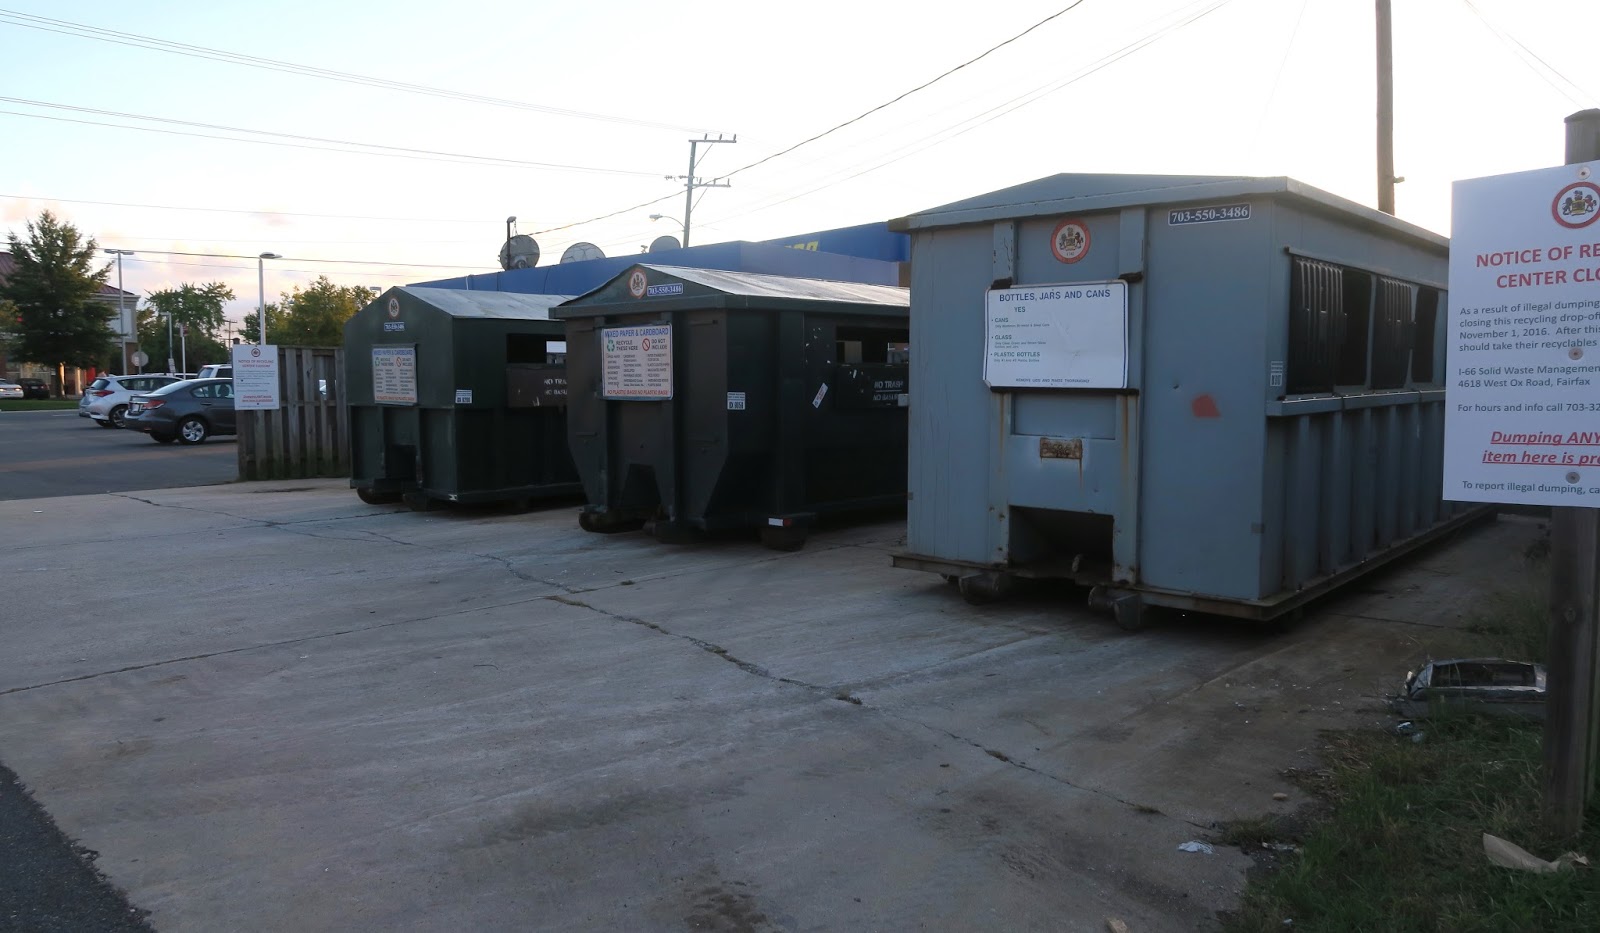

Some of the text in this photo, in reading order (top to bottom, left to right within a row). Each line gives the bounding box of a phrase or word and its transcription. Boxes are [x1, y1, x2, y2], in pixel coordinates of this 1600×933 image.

[1171, 205, 1248, 222] 703-550-3486
[1476, 248, 1542, 267] NOTICE
[1547, 245, 1573, 261] OF
[1496, 270, 1567, 289] CENTER
[999, 289, 1111, 302] BOTTLES, JARS AND CANS
[1460, 307, 1470, 315] As
[1481, 305, 1508, 314] result
[1510, 304, 1521, 312] of
[1523, 302, 1551, 313] illegal
[1554, 299, 1600, 310] dumping
[1460, 319, 1491, 328] closing
[1494, 317, 1511, 325] this
[1513, 314, 1557, 325] recycling
[620, 329, 635, 337] PAPER
[639, 327, 669, 336] CARDBOARD
[1460, 330, 1508, 340] November
[1511, 330, 1520, 338] 1,
[1523, 328, 1550, 337] 2016.
[1555, 326, 1582, 335] After
[1459, 338, 1598, 352] should take their recyclables
[1458, 367, 1477, 376] I-66
[1478, 366, 1501, 375] Solid
[1504, 366, 1534, 374] Waste
[874, 380, 903, 388] NO TRASH
[1458, 377, 1591, 388] 4618 West Ox Road, Fairfax
[1457, 404, 1473, 412] For
[1475, 403, 1501, 412] hours
[1503, 403, 1522, 412] and
[1524, 403, 1544, 412] info
[1546, 403, 1563, 412] call
[1490, 431, 1563, 446] Dumping
[1482, 450, 1517, 464] item
[1521, 450, 1557, 464] here
[1561, 451, 1575, 465] is
[1462, 480, 1473, 489] To
[1475, 482, 1505, 491] report
[1507, 482, 1535, 493] illegal
[1538, 484, 1586, 495] dumping,
